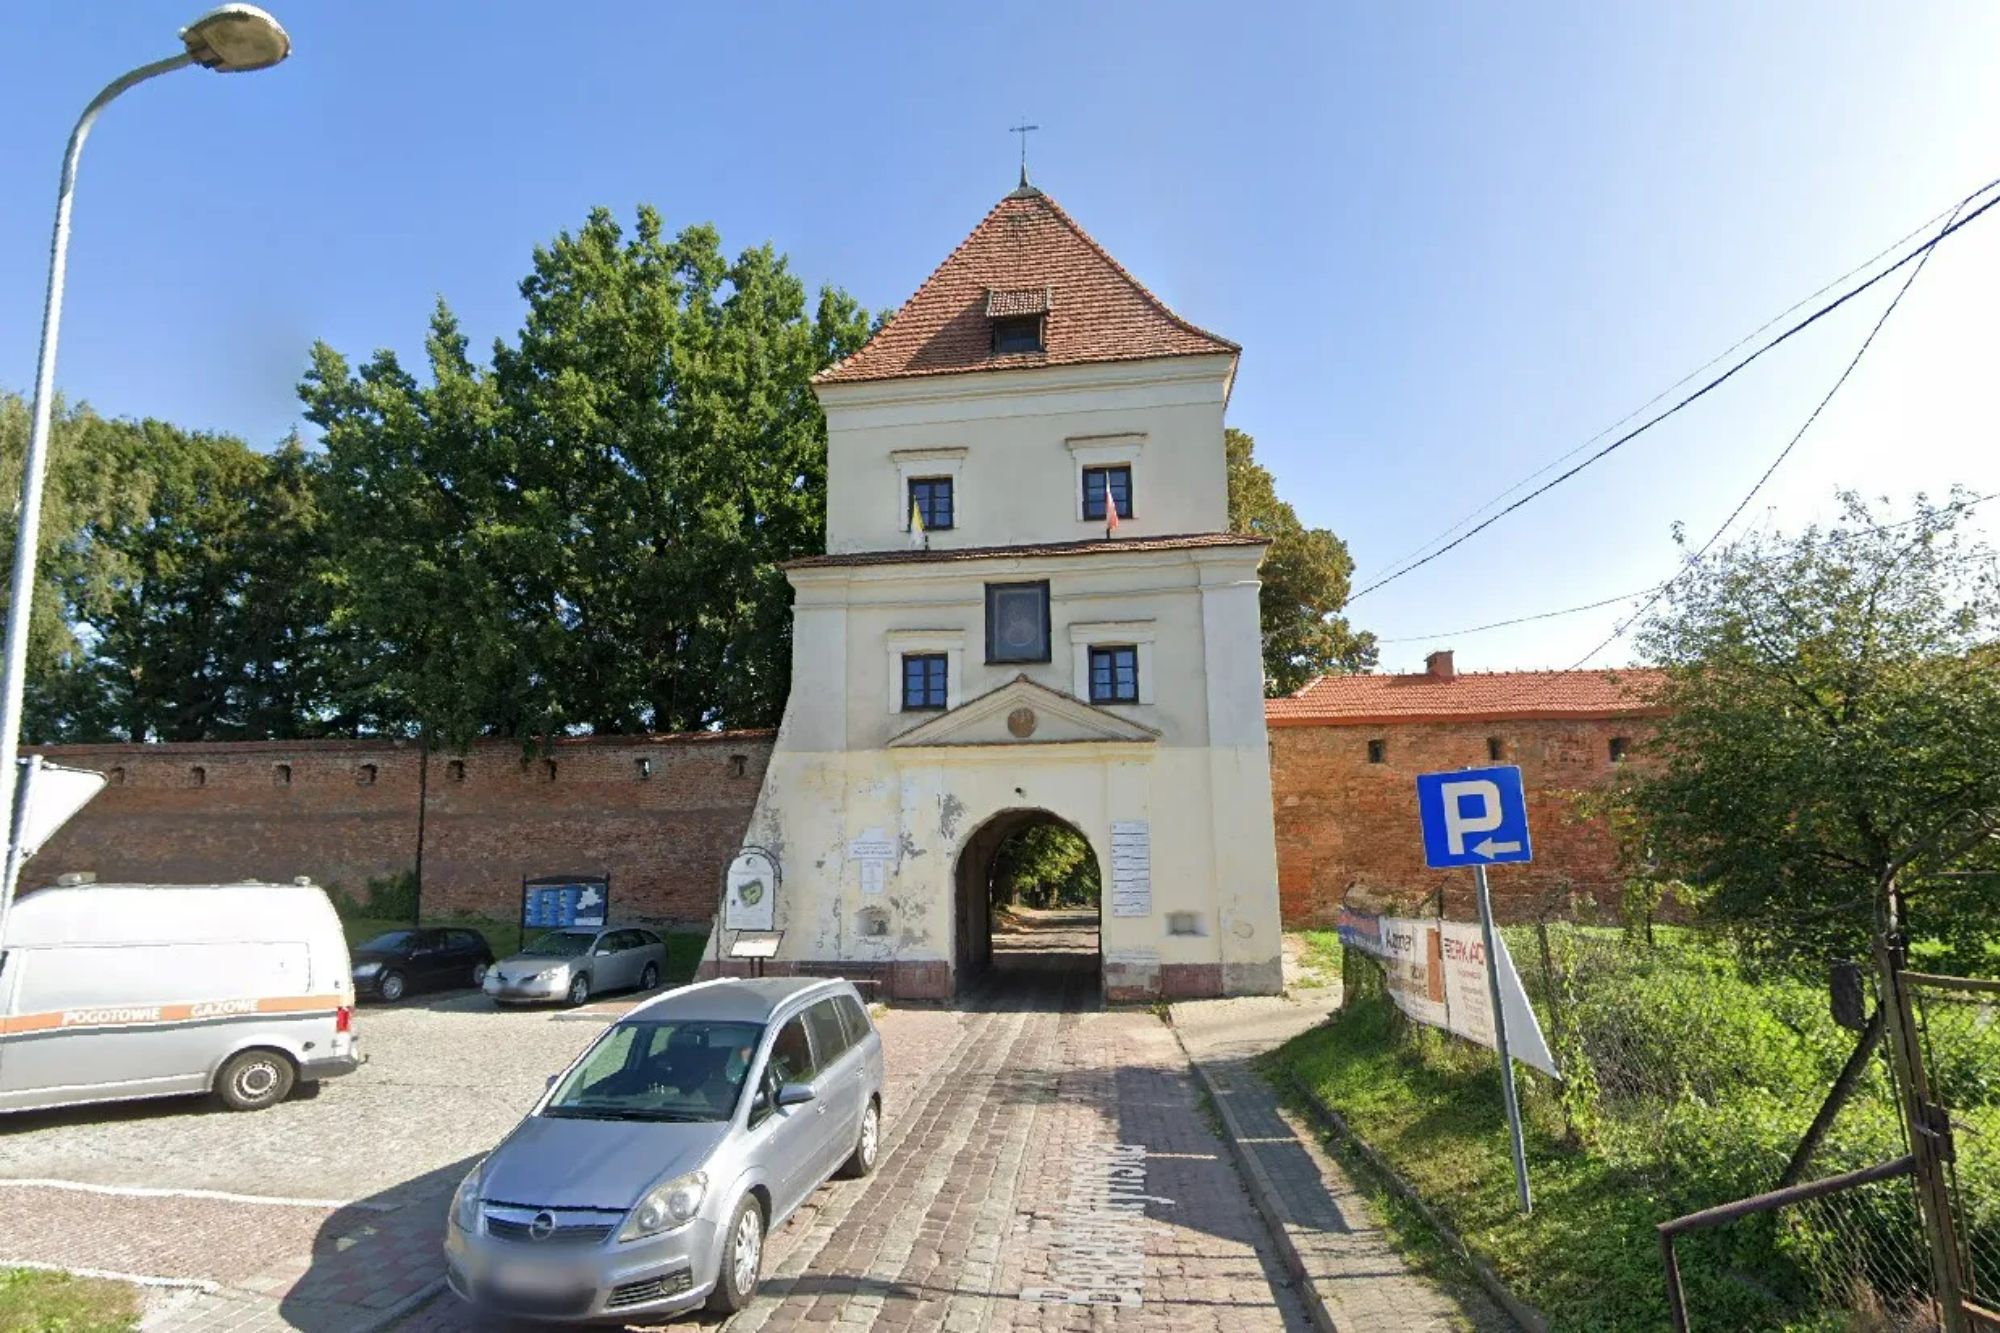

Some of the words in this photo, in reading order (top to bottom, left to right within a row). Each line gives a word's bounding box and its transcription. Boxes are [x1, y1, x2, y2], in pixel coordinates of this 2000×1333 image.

[1441, 780, 1502, 854] P
[63, 1008, 160, 1026] POGOTOWIE
[191, 1000, 258, 1017] GAZOWE
